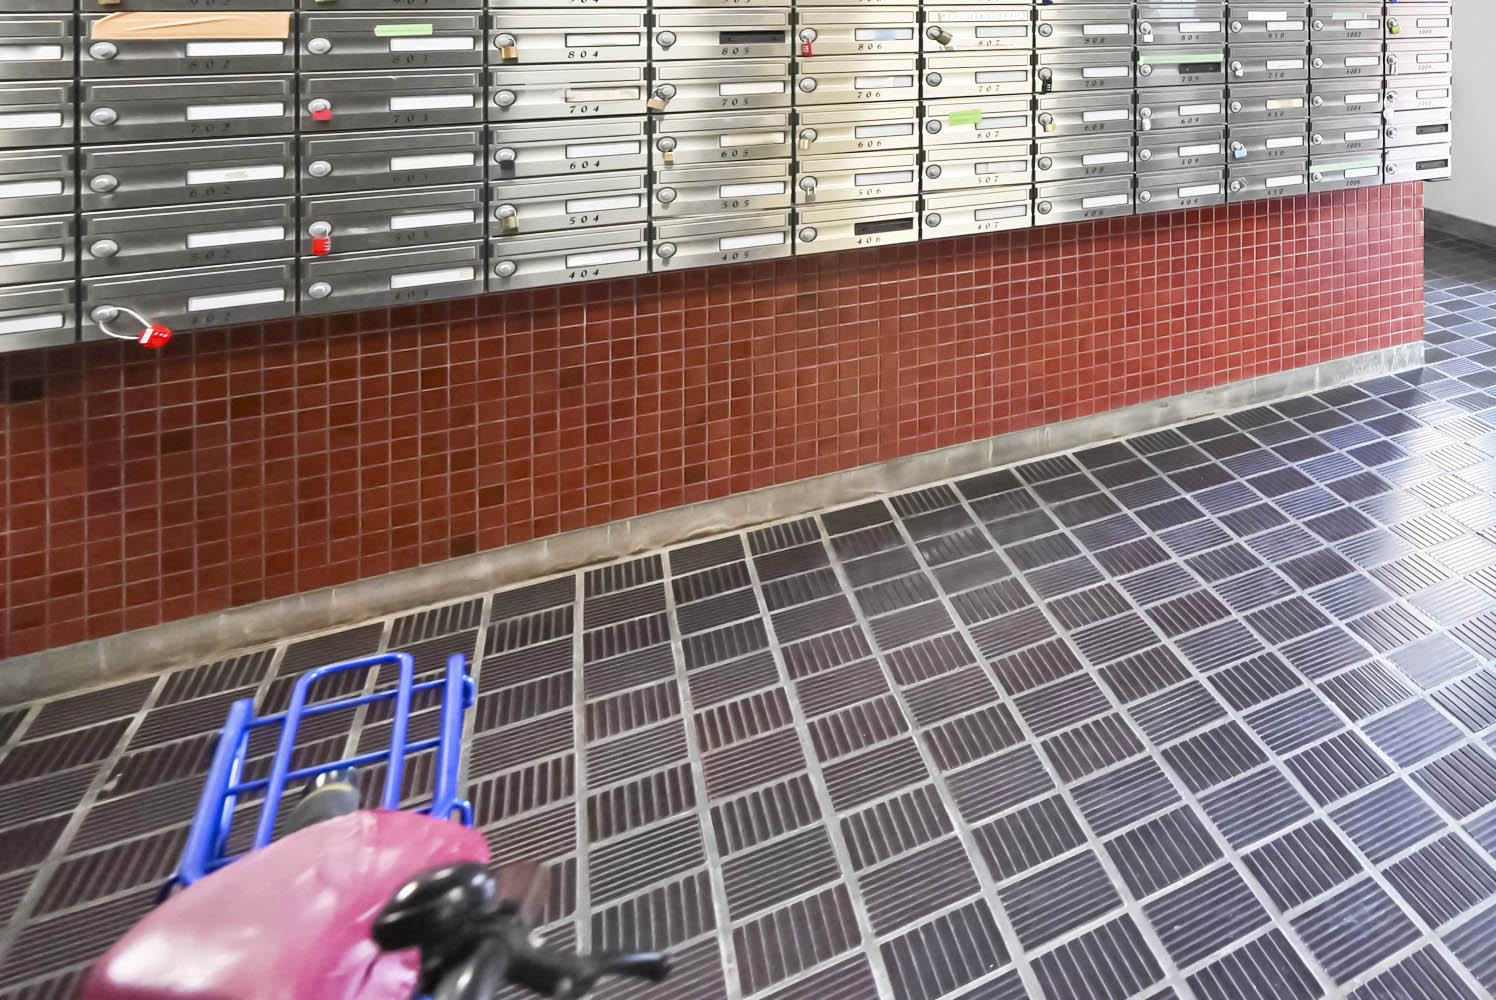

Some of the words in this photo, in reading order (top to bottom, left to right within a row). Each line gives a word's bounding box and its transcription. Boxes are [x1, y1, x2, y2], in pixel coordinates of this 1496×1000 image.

[567, 50, 599, 59] 804
[721, 47, 750, 56] 805
[857, 91, 881, 99] 706
[721, 98, 749, 107] 705
[570, 104, 600, 114] 704
[857, 140, 882, 149] 606
[721, 150, 749, 158] 605
[569, 160, 601, 170] 604
[721, 199, 750, 209] 505
[569, 214, 600, 225] 504
[721, 252, 750, 261] 405
[568, 268, 600, 279] 404
